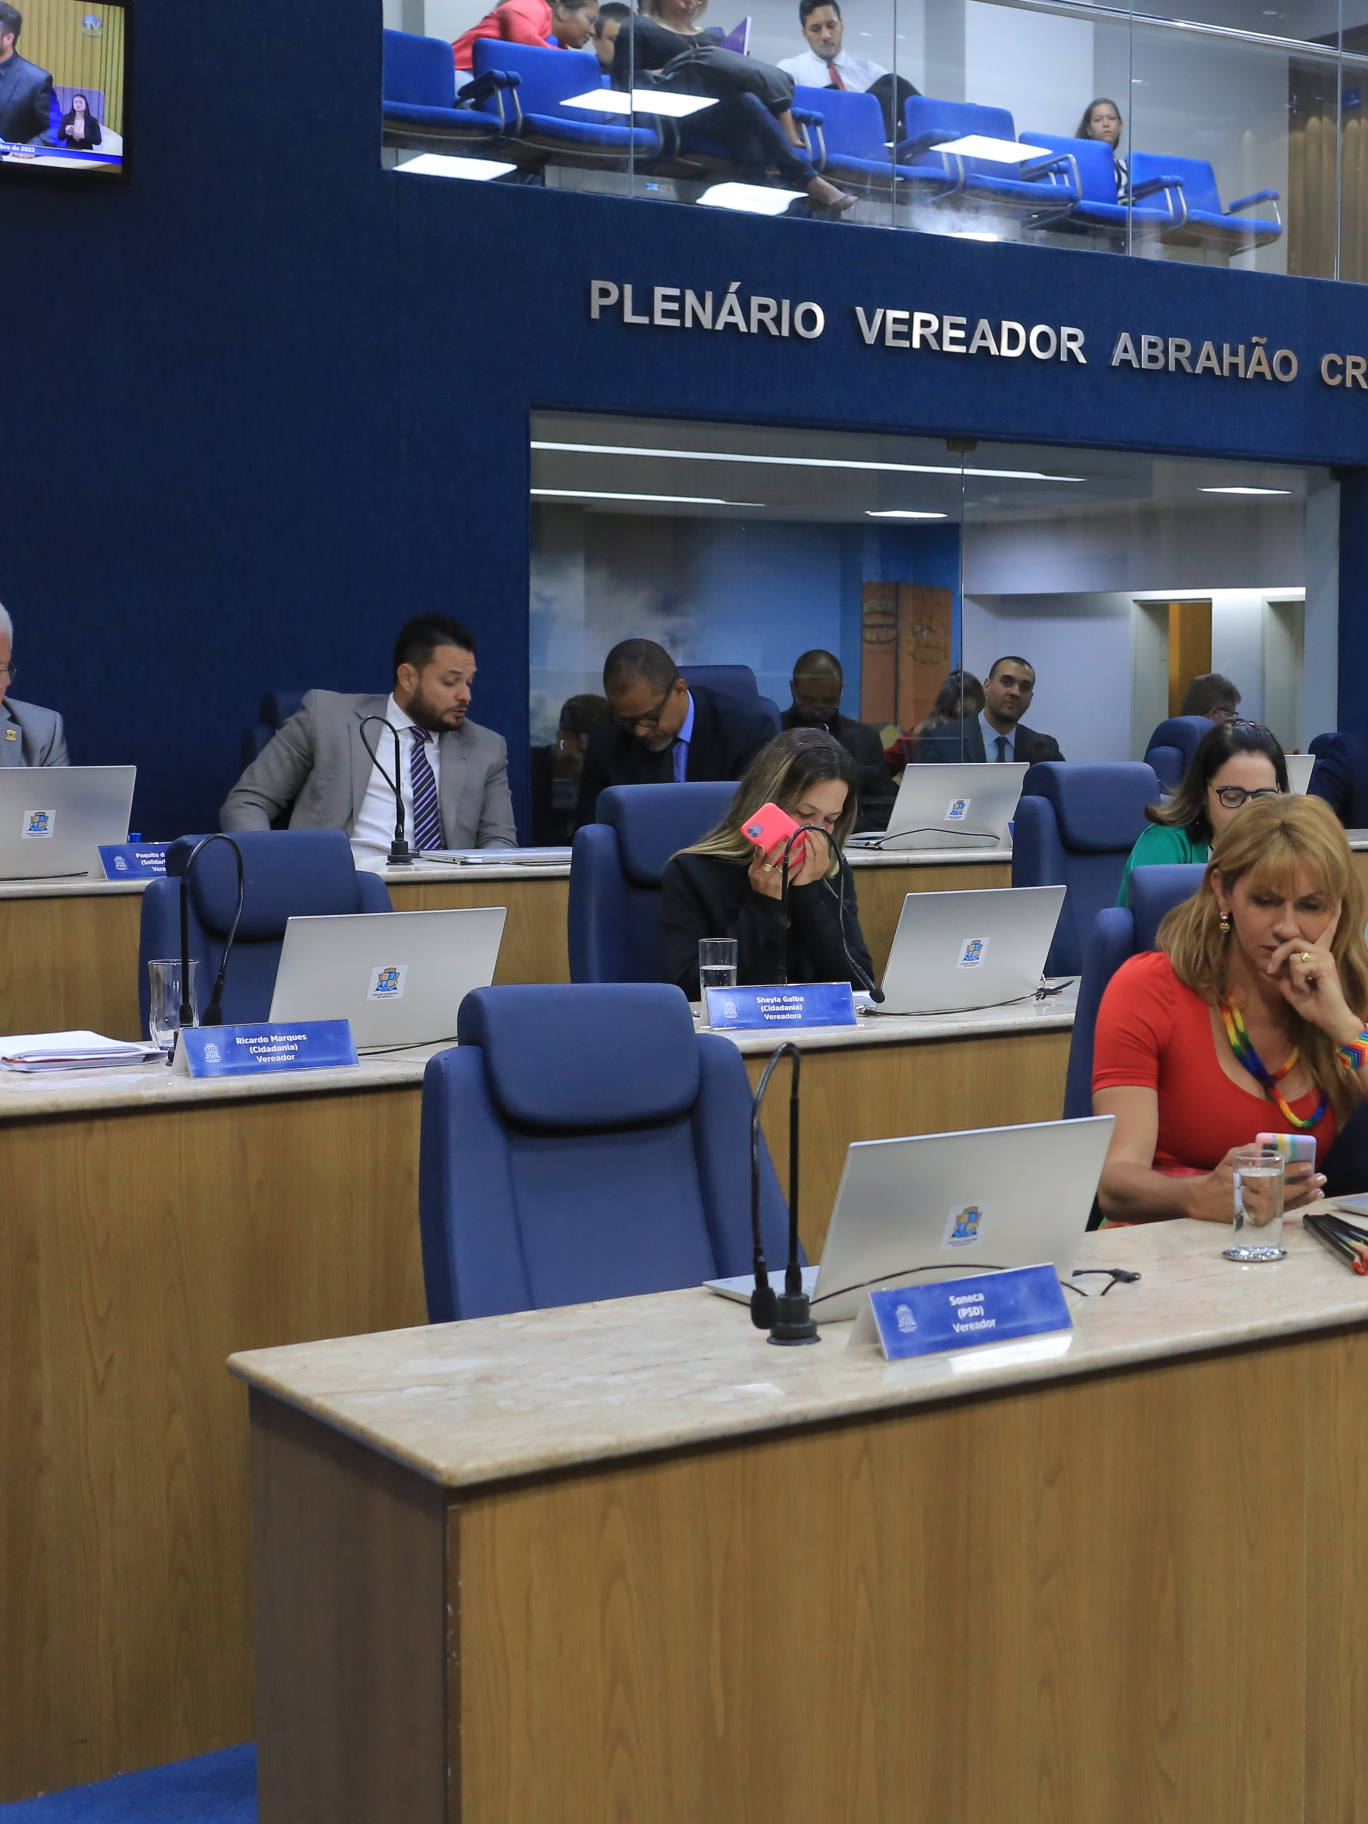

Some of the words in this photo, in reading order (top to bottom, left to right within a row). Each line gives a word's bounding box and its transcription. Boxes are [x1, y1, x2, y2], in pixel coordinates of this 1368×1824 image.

[590, 280, 825, 338] PLENÁRIO
[855, 306, 1087, 364] VEREADOR
[1110, 332, 1298, 382] ABRAHÃO
[761, 1004, 802, 1012] (Cidadania)
[236, 1036, 268, 1045] Ricardo
[270, 1033, 307, 1043] Marques
[250, 1043, 298, 1054] (Cidadania)
[256, 1053, 295, 1063] Vereador
[949, 1292, 984, 1306] Soneca
[958, 1305, 984, 1320] (PSD)
[952, 1317, 996, 1333] Vereador
